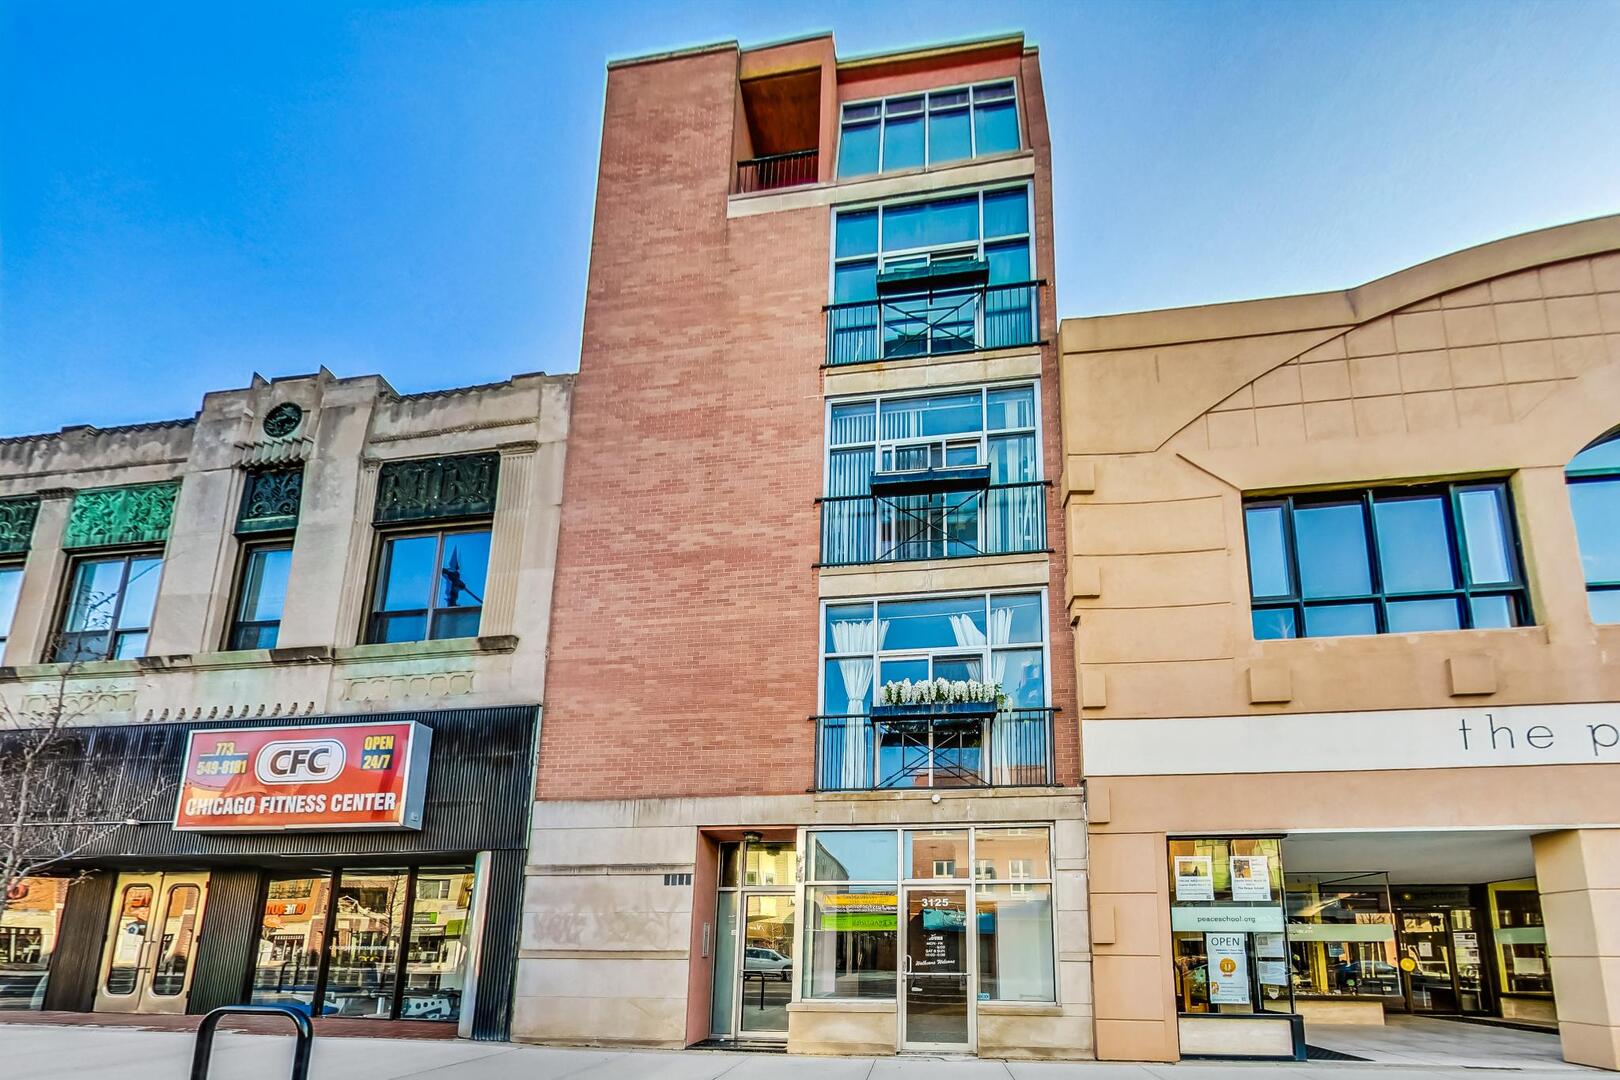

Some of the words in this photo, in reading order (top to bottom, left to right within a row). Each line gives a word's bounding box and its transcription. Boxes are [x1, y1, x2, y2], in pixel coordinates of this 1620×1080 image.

[1458, 714, 1554, 750] the
[215, 742, 236, 756] 773
[364, 735, 394, 750] OPEN
[270, 747, 329, 775] CFC
[362, 754, 389, 769] 24/7
[185, 796, 255, 817] CHICAGO
[259, 794, 326, 815] FITNESS
[330, 792, 396, 812] CENTER
[921, 898, 949, 907] 3125
[1211, 937, 1240, 946] OPEN
